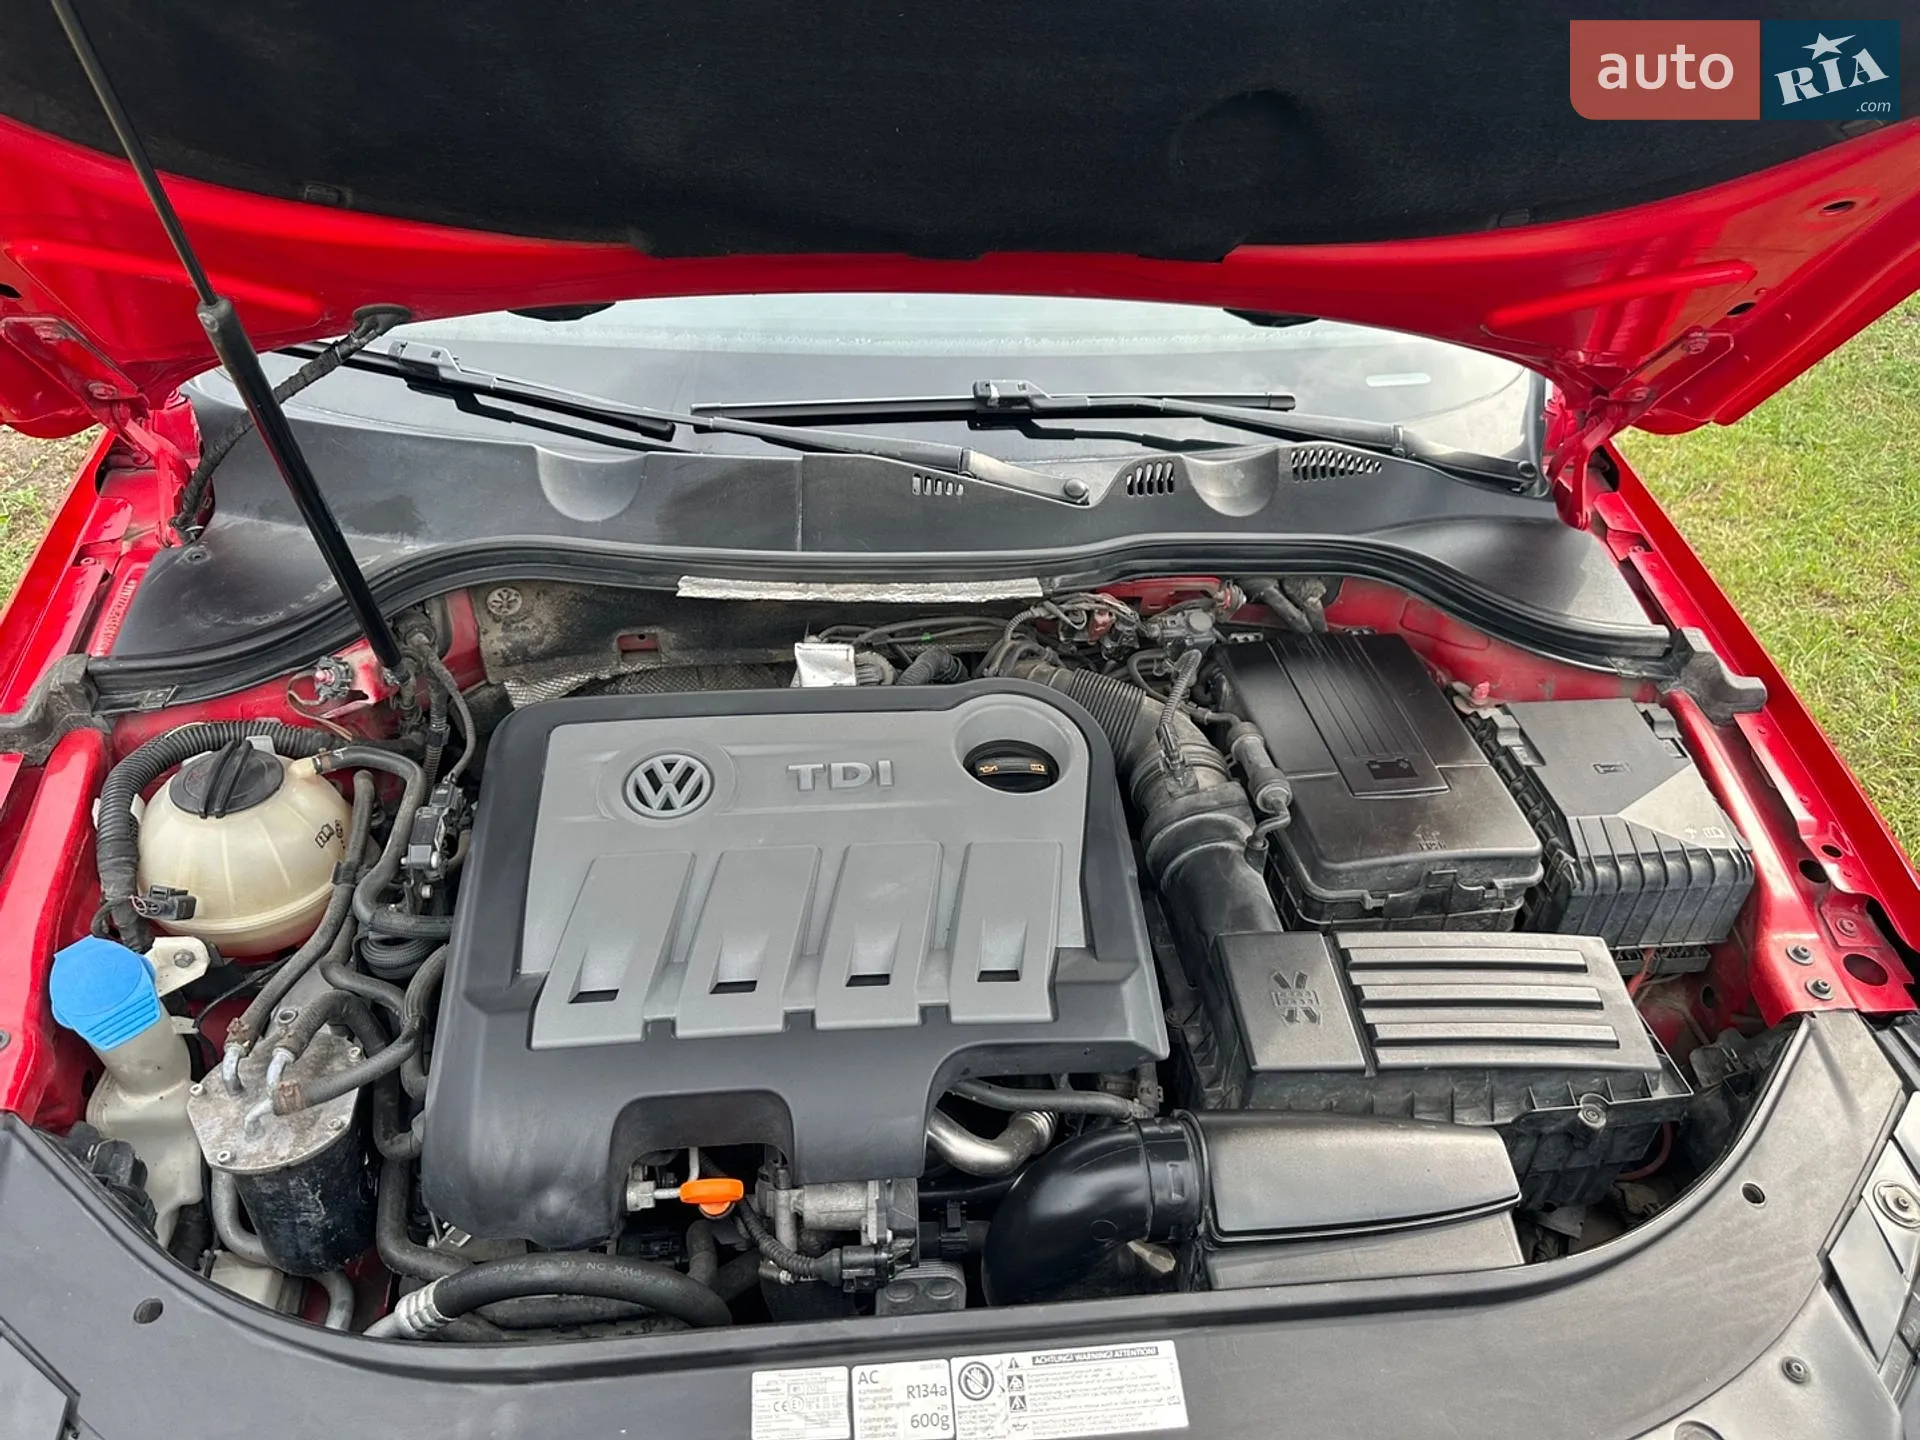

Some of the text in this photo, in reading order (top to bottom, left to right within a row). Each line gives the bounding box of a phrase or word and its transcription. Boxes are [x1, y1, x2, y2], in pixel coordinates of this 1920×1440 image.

[786, 759, 894, 791] TDI
[857, 1370, 879, 1384] AC
[906, 1383, 948, 1399] R134a
[911, 1412, 950, 1430] 600g
